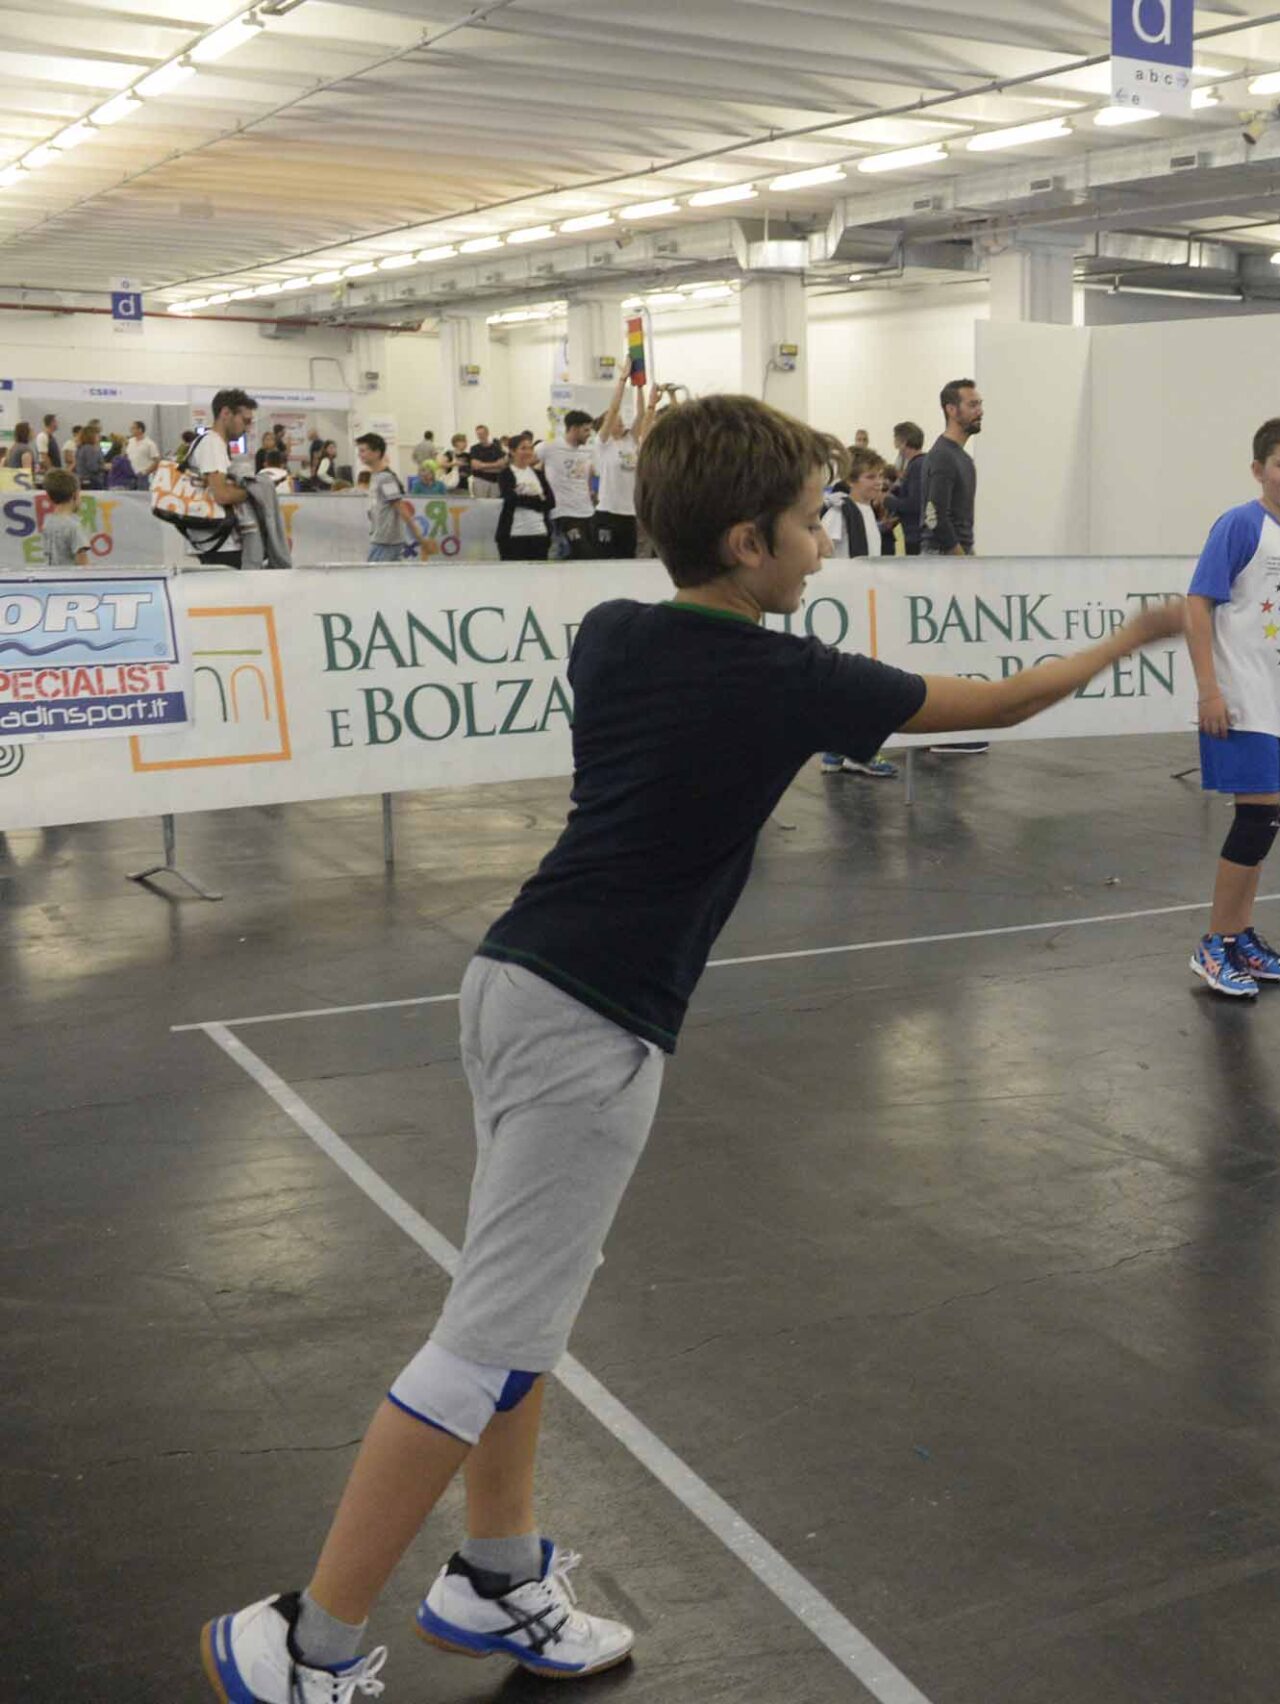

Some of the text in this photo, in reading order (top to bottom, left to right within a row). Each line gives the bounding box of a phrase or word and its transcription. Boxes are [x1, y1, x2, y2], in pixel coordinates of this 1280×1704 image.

[118, 294, 135, 316] d
[3, 493, 123, 538] SPRT
[314, 605, 560, 672] BANCA
[904, 593, 1059, 645] BANK
[1062, 601, 1126, 640] FÜR
[327, 675, 576, 748] E BOLZA
